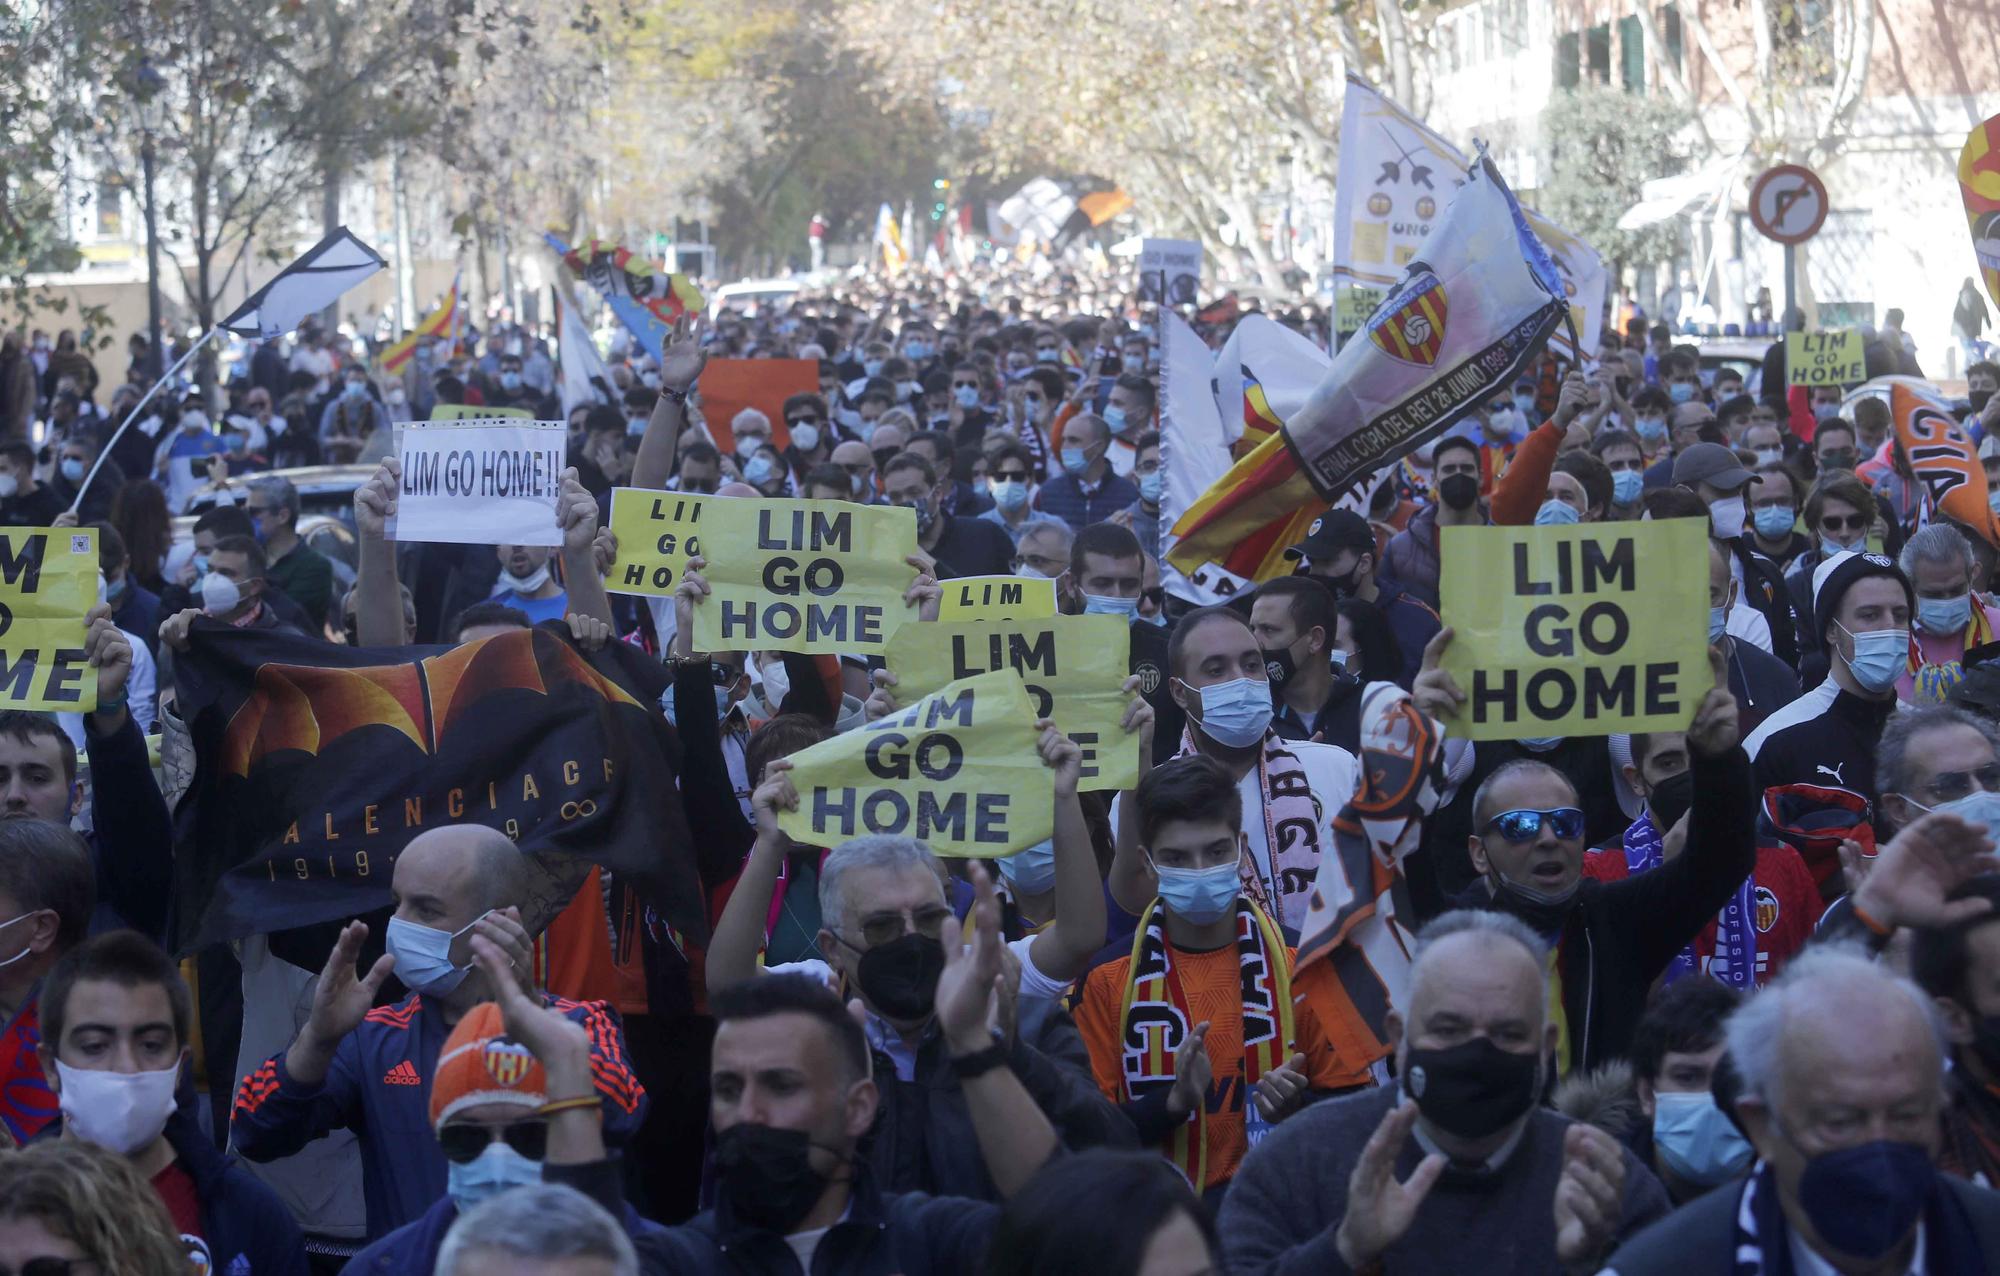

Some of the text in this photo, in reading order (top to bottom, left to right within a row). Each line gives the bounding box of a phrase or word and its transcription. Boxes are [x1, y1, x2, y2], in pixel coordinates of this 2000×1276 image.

[1351, 289, 1379, 300] LIM
[1354, 302, 1375, 313] GO
[1792, 362, 1862, 382] HOME
[1814, 352, 1838, 366] GO
[1318, 347, 1508, 480] FINAL COPA DEL REY 26 JUNIO 1999
[403, 451, 440, 496] LIM
[444, 450, 475, 497] GO
[657, 533, 699, 558] GO
[758, 509, 851, 552] LIM
[762, 556, 844, 597] GO
[1514, 538, 1636, 595] LIM
[960, 583, 1023, 607] LIM
[721, 600, 883, 643] HOME
[1524, 601, 1630, 657] GO
[951, 630, 1057, 681] LIM
[1472, 661, 1681, 723] HOME
[864, 732, 964, 781] GO
[811, 785, 1011, 844] HOME
[383, 1075, 421, 1085] adidas
